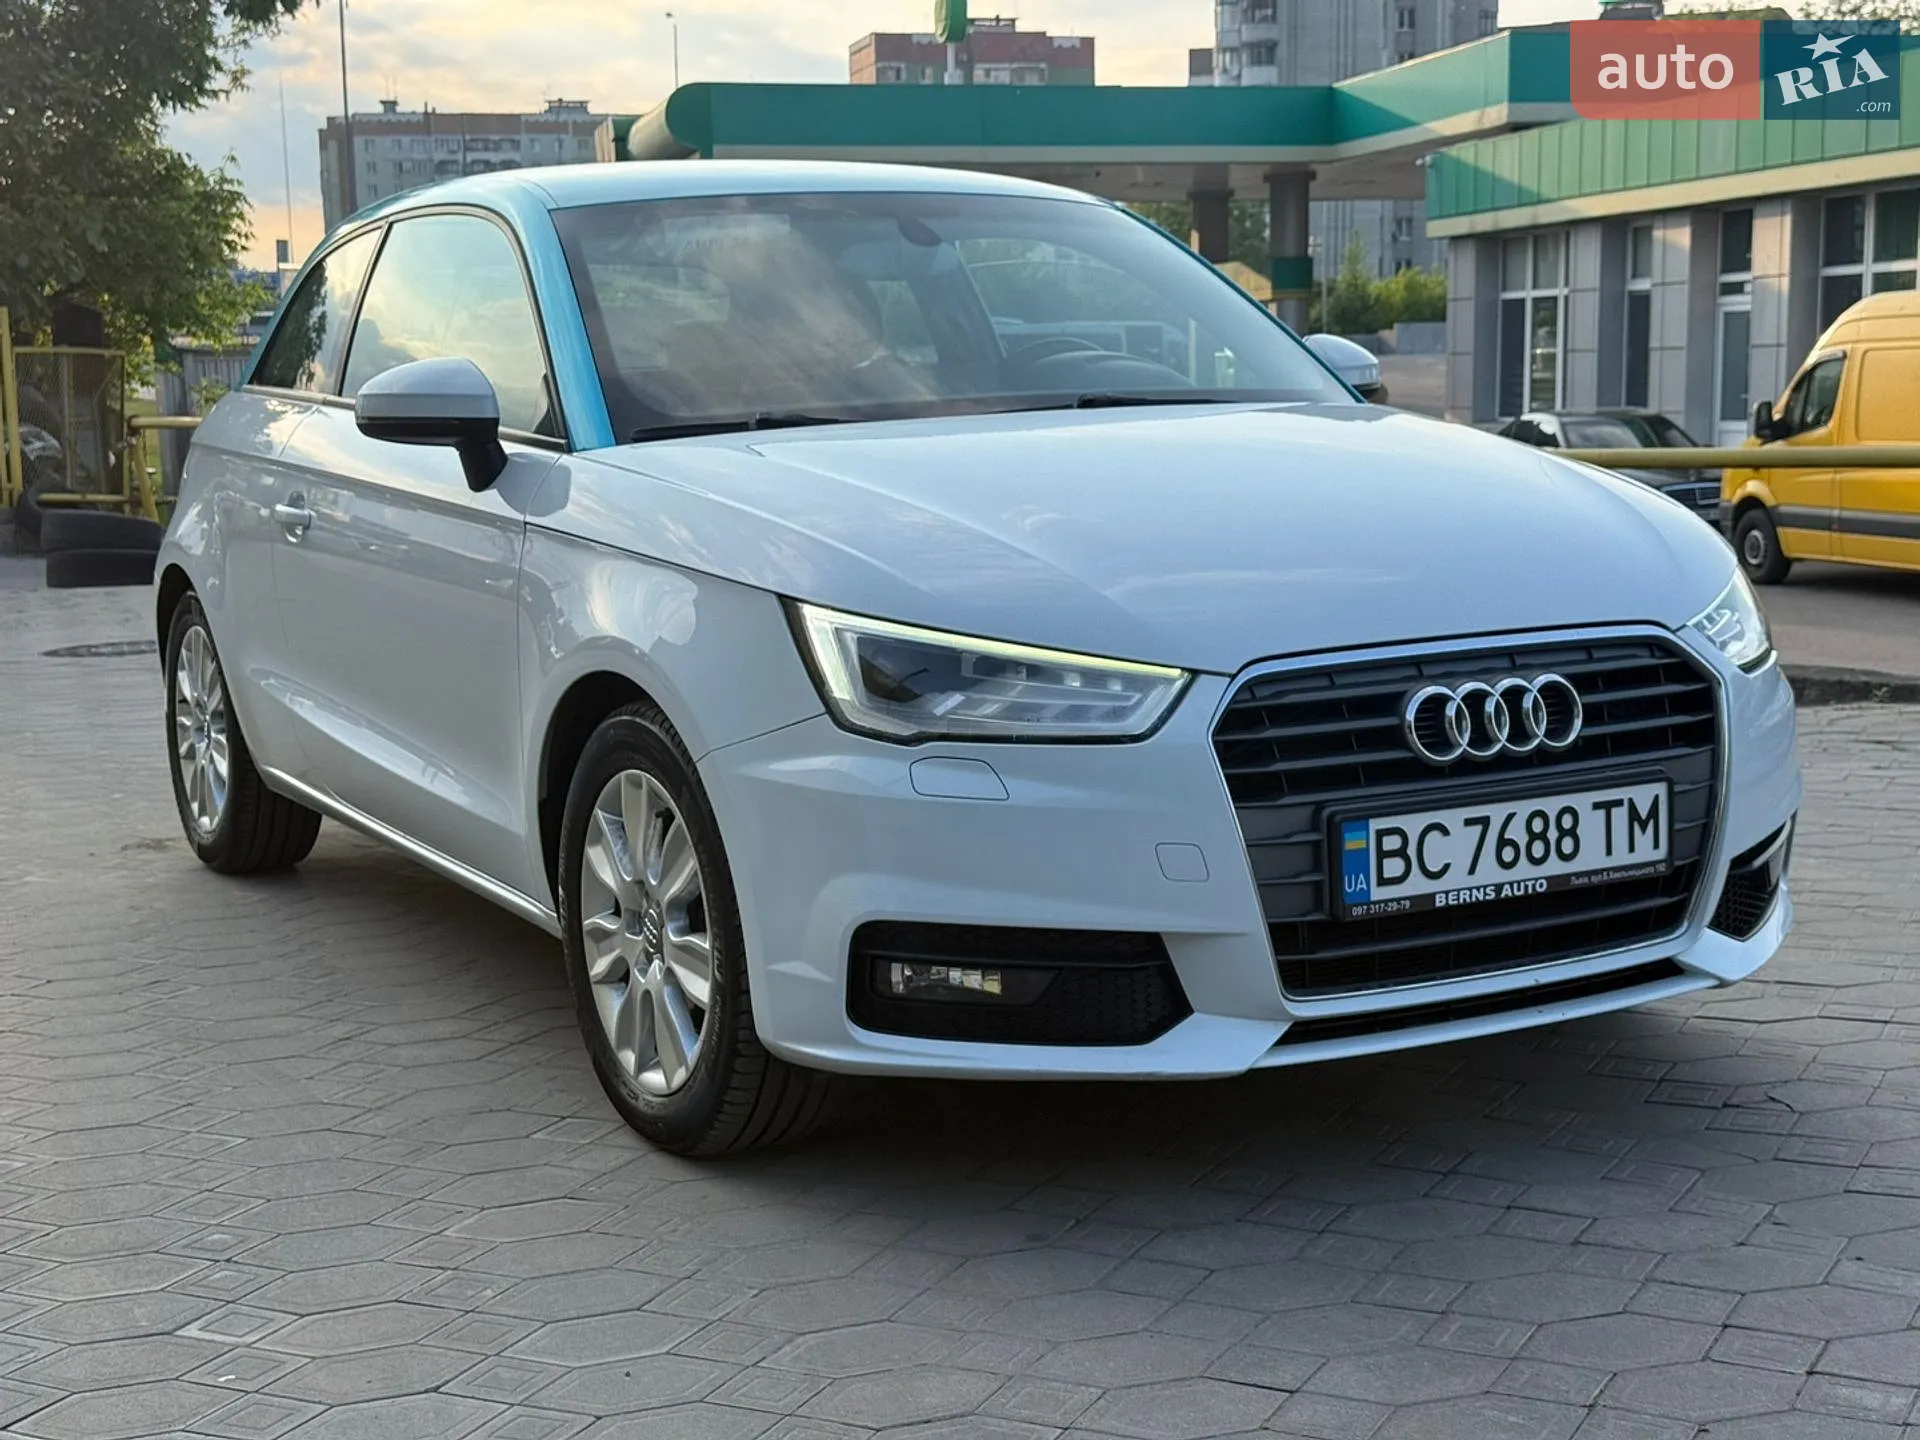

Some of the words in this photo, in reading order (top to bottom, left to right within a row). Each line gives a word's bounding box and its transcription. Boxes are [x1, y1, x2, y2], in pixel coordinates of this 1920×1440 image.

[1375, 822, 1452, 887] BC
[1463, 805, 1581, 876] 7688
[1592, 793, 1660, 857] TM
[1344, 874, 1368, 893] UA
[1435, 886, 1497, 908] BERNS
[1500, 879, 1548, 899] AUTO
[1352, 905, 1368, 917] 097
